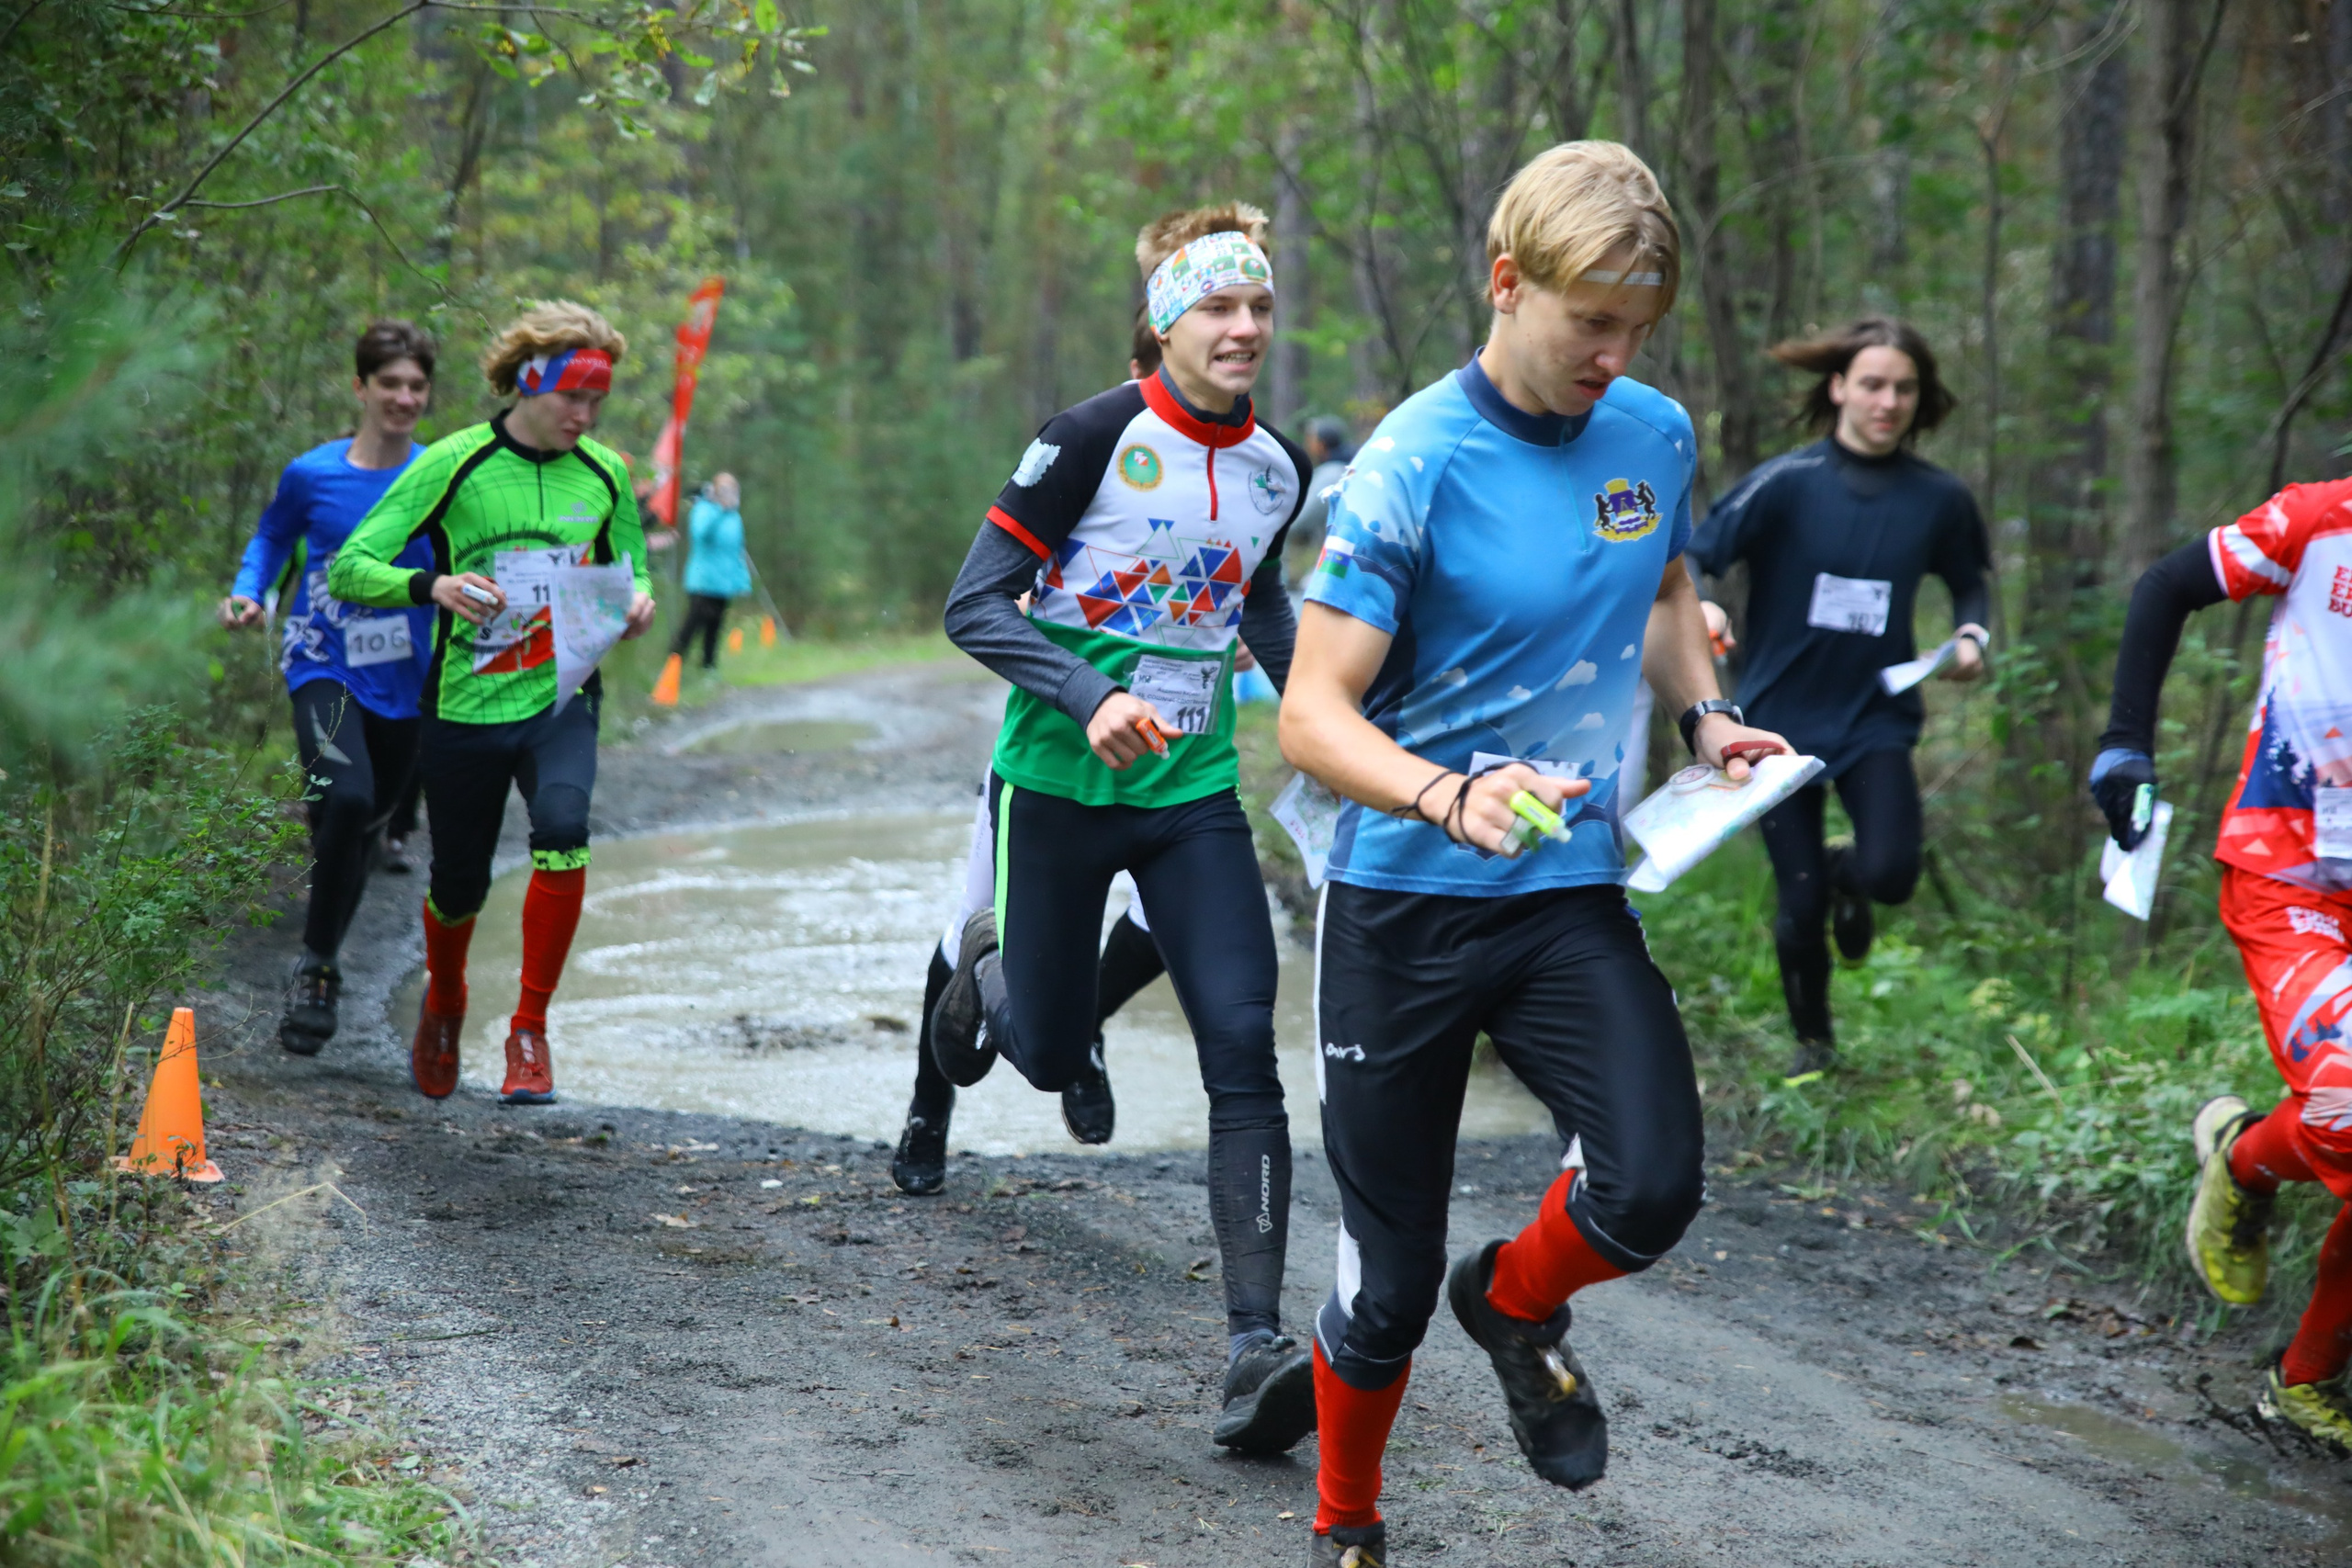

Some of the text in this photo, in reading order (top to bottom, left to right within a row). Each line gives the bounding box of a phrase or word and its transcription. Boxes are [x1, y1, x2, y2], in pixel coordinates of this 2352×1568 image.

[532, 584, 551, 604] 11
[354, 626, 406, 653] 106
[1177, 706, 1205, 732] 111
[1261, 1154, 1270, 1212] NORD
